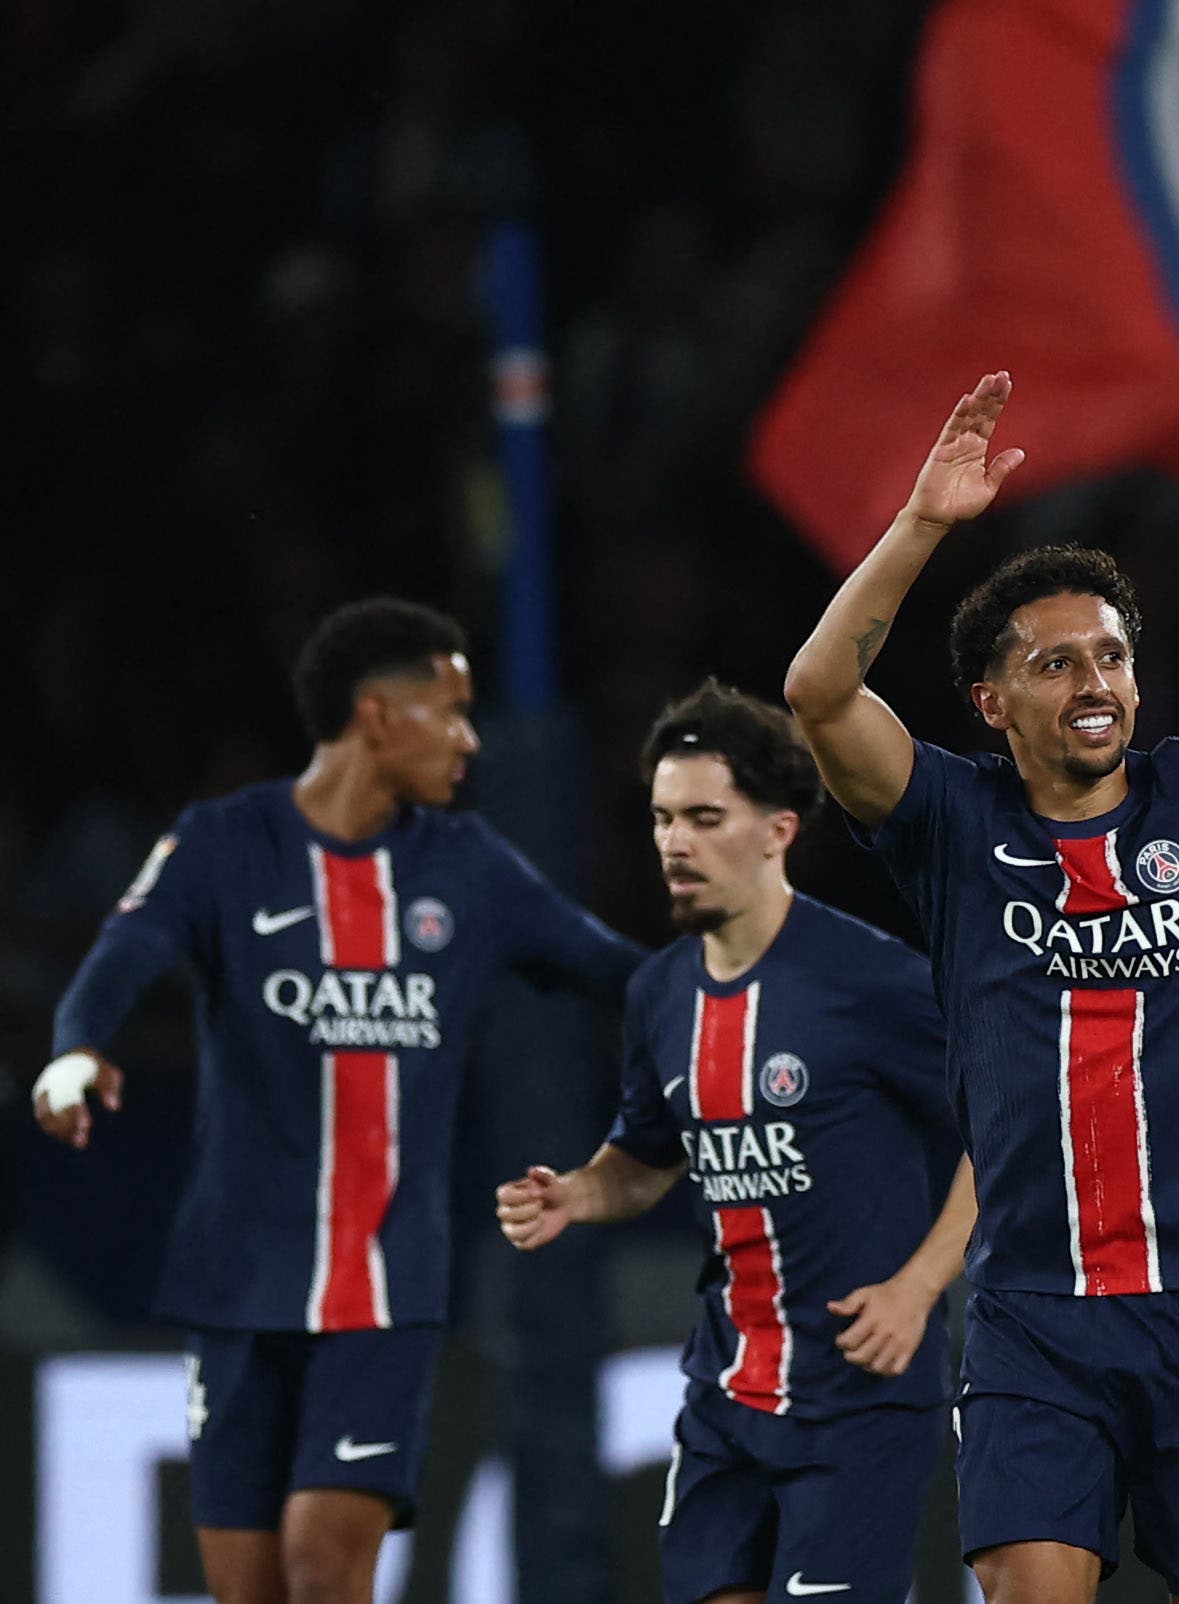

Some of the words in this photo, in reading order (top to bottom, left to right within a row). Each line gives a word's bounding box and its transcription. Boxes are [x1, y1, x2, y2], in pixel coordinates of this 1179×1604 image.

[1139, 843, 1170, 866] PARIS
[263, 968, 438, 1026] QATAR
[309, 1015, 442, 1049] AIRWAYS
[703, 1163, 813, 1202] AIRWAYS
